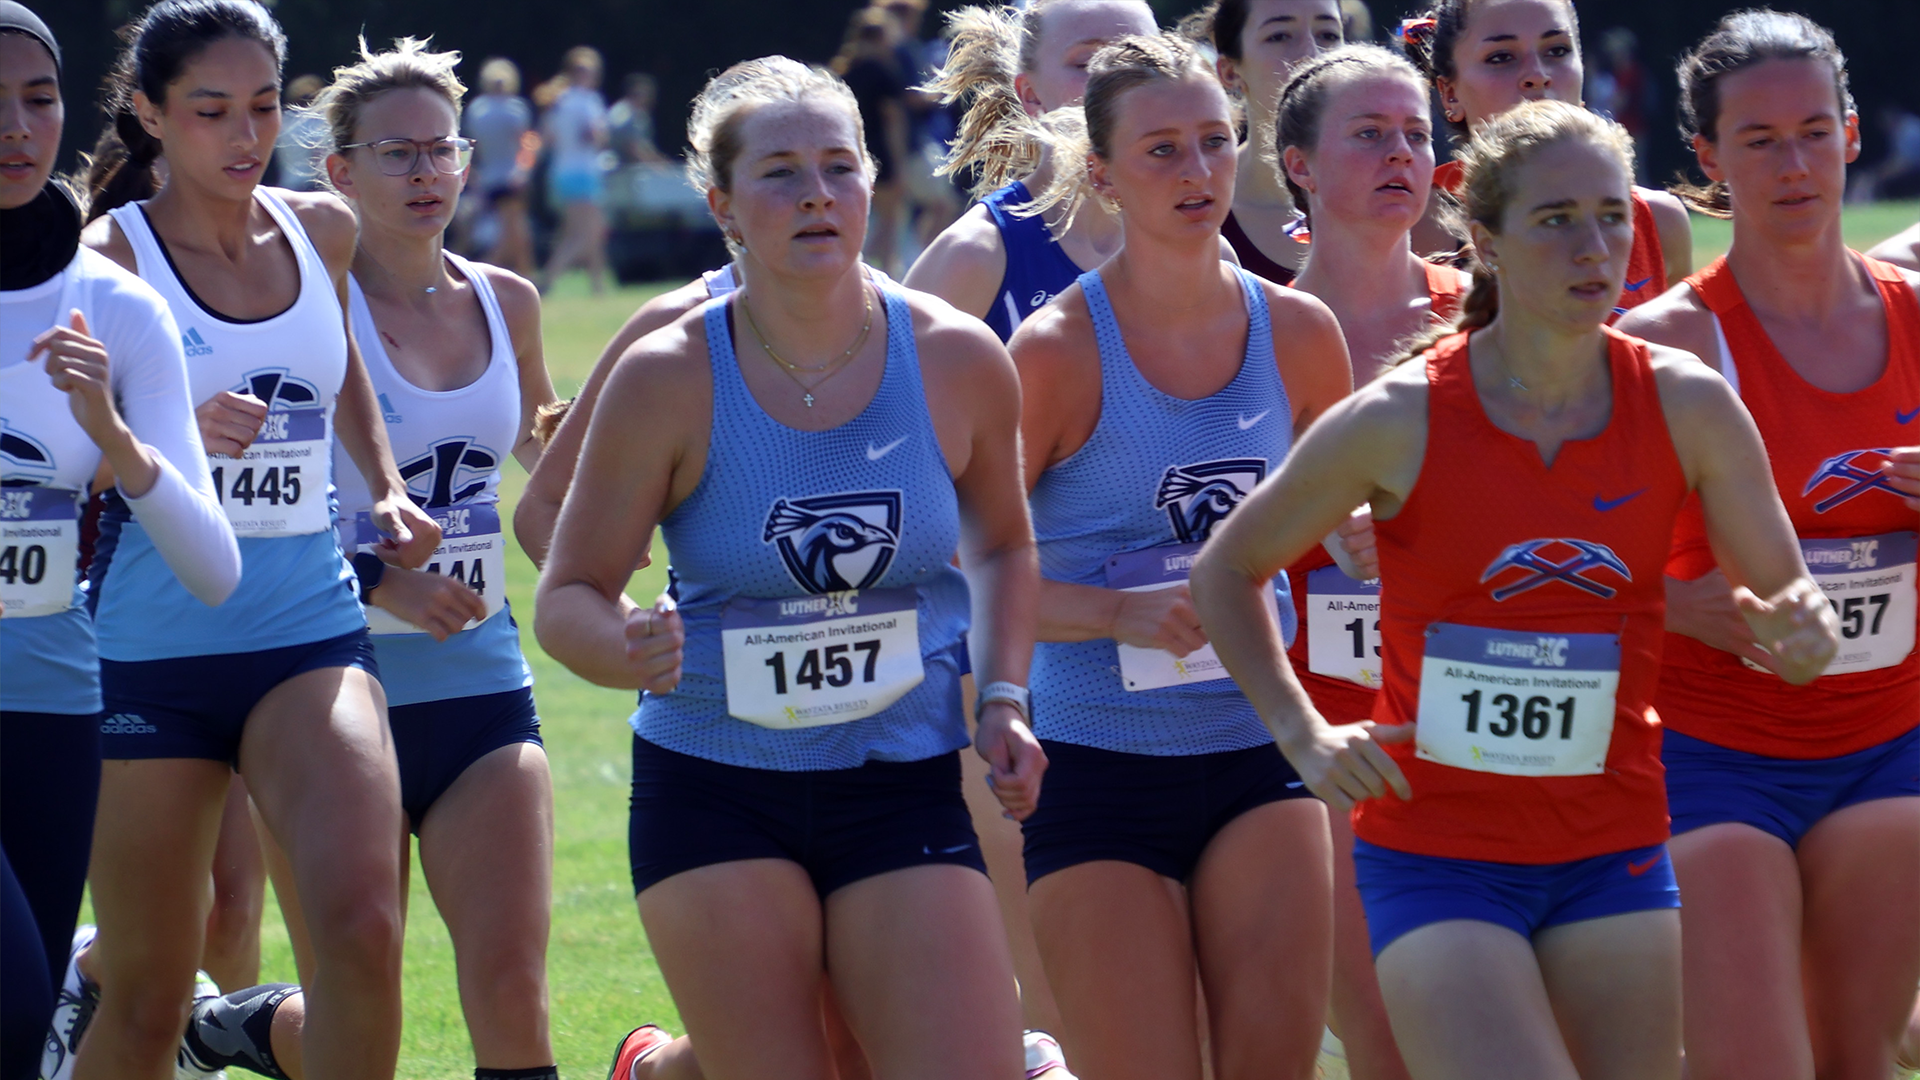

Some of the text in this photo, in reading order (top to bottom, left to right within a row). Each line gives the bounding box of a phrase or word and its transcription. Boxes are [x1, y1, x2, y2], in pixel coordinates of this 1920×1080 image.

[263, 447, 311, 458] Invitational
[212, 466, 300, 506] 1445
[3, 527, 61, 537] Invitational
[448, 540, 492, 554] Invitational
[1849, 572, 1903, 588] Invitational
[1829, 593, 1891, 640] 57
[745, 619, 897, 646] All-American Invitational
[765, 639, 881, 695] 1457
[1445, 668, 1601, 689] All-American Invitational
[1461, 689, 1576, 740] 1361
[100, 724, 157, 734] adidas
